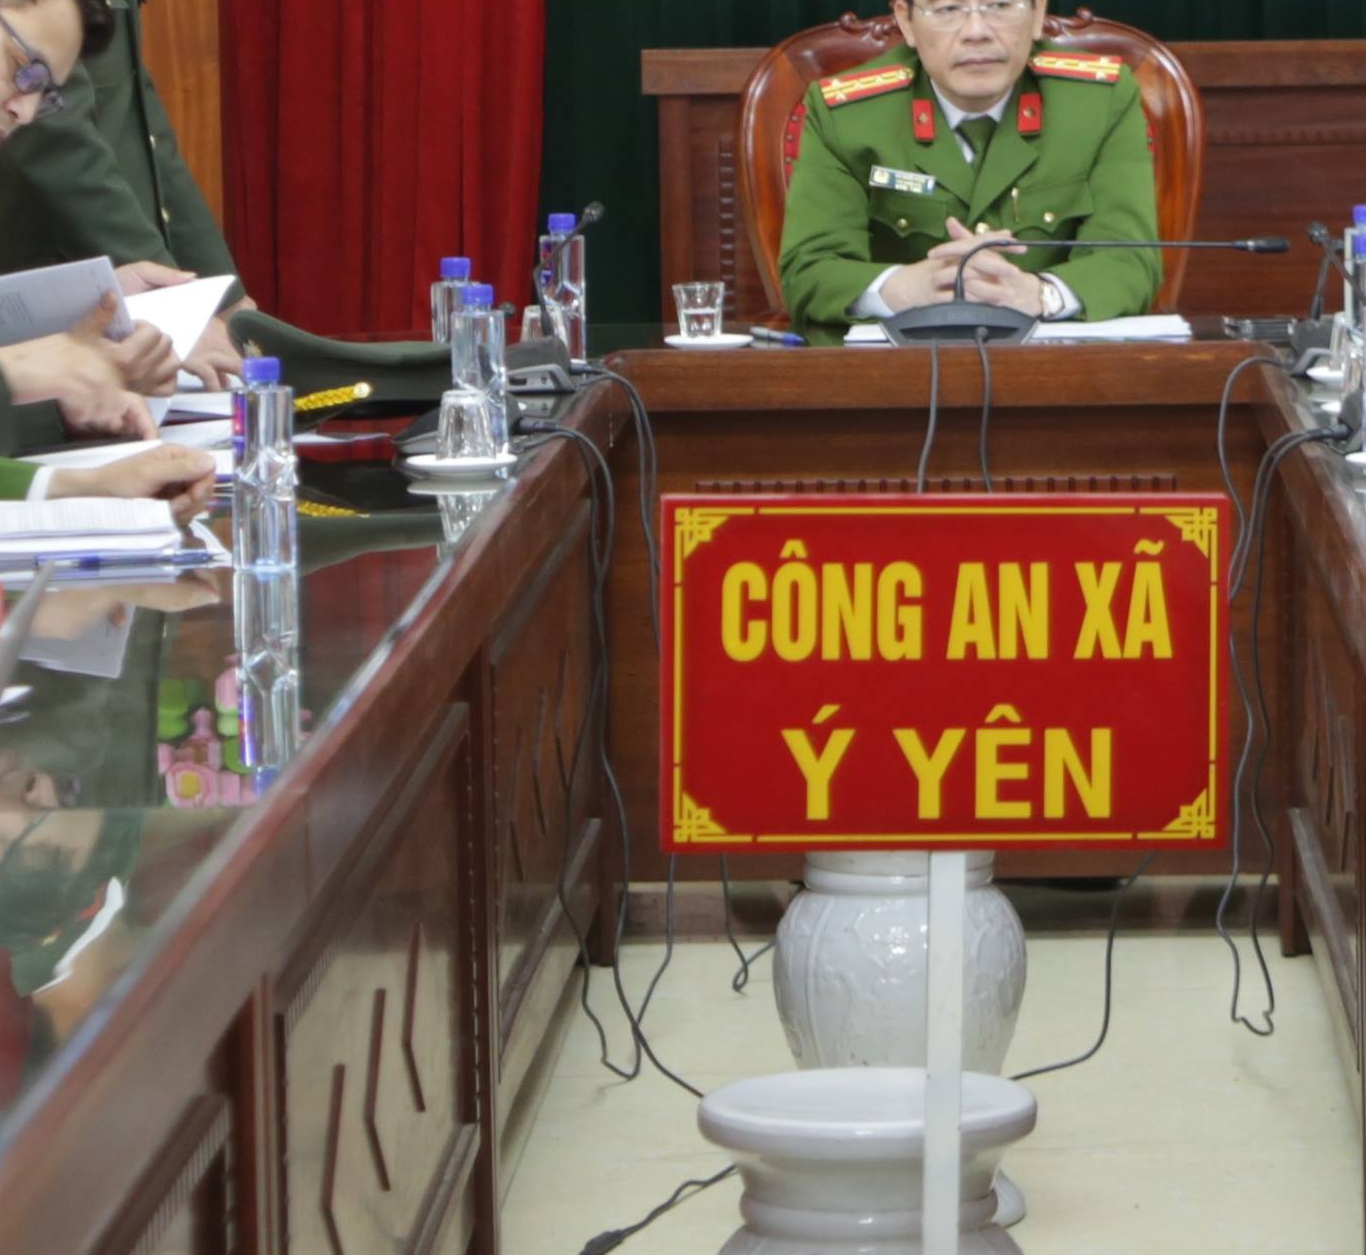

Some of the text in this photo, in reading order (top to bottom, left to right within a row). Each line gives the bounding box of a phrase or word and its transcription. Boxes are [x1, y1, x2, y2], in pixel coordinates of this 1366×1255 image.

[721, 538, 1173, 662] CÔNG AN XÃ
[781, 704, 1112, 820] Ý YÊN
